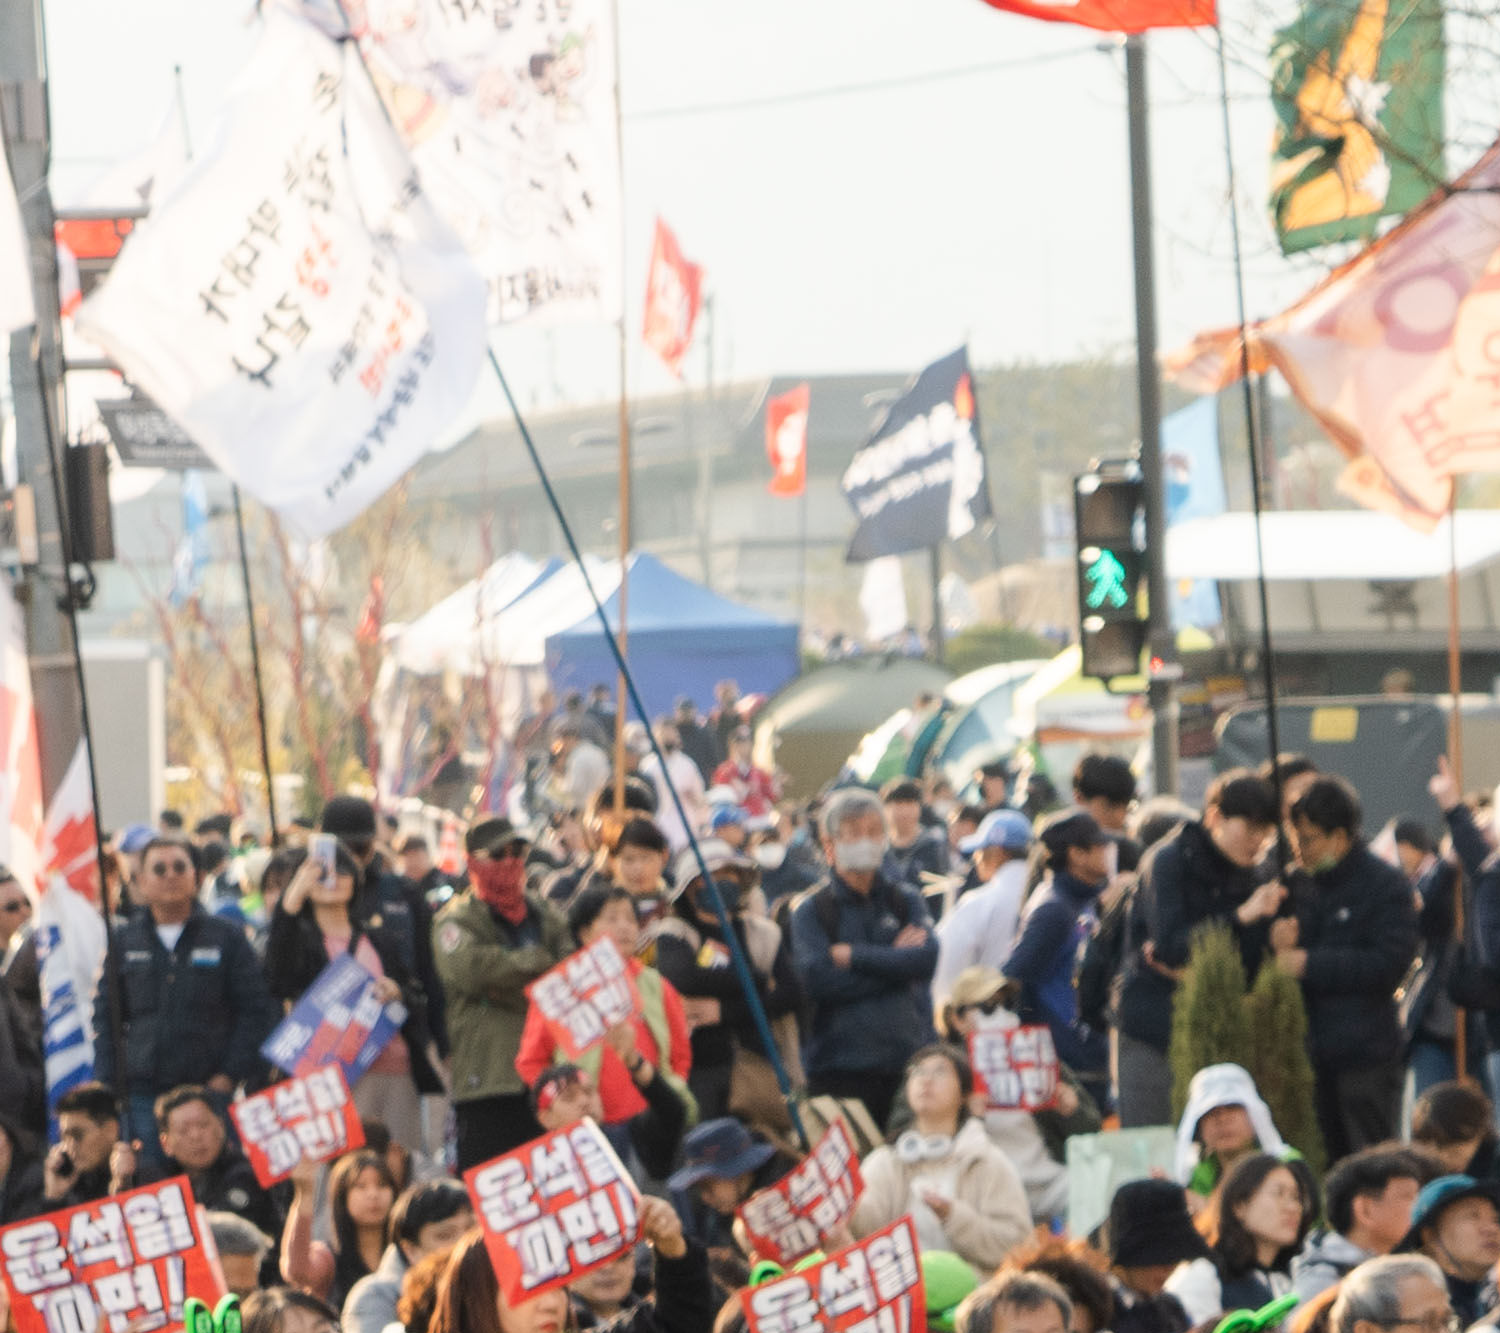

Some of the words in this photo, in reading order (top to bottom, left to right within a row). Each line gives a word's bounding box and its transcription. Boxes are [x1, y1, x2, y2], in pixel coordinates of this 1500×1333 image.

[990, 1066, 1054, 1107] 파면
[475, 1126, 620, 1232] 윤석열
[3, 1184, 195, 1292] 윤석열
[515, 1195, 640, 1289] 파면!
